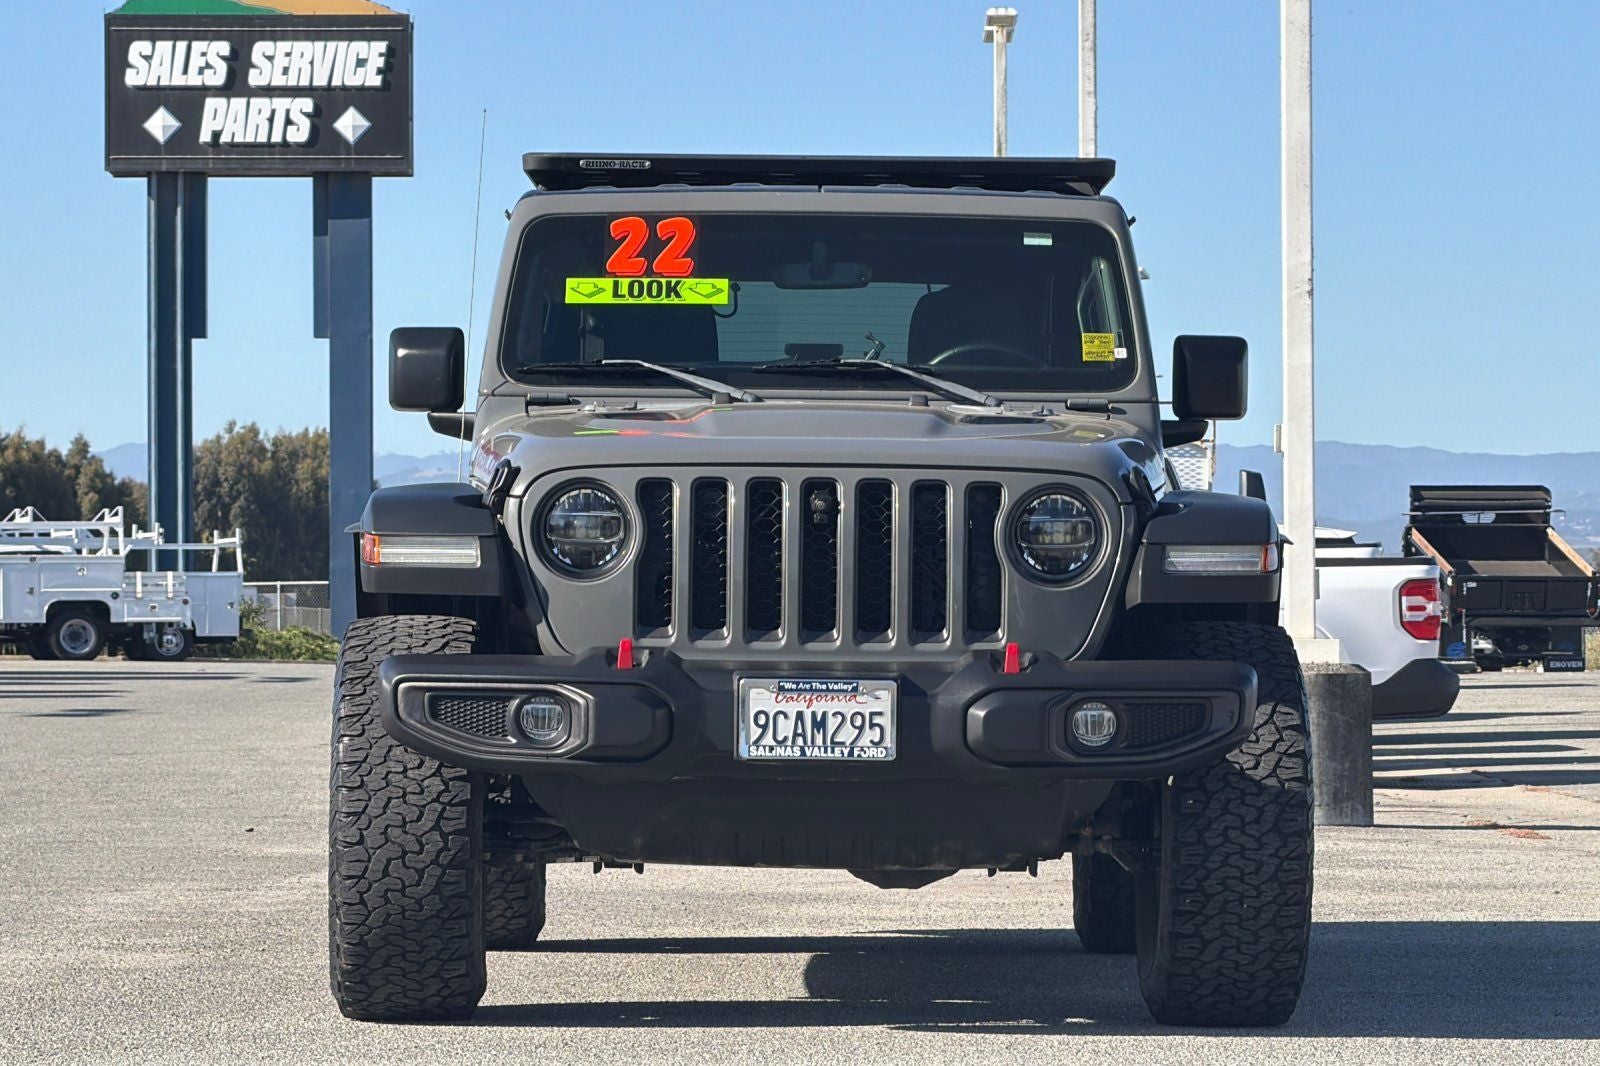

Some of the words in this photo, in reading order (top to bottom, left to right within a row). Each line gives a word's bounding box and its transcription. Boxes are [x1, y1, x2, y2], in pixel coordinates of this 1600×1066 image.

[124, 40, 232, 88] SALES
[247, 40, 388, 88] SERVICE
[198, 96, 315, 145] PARTS
[606, 216, 696, 277] 22
[611, 279, 685, 301] LOOK
[1550, 660, 1583, 668] ENOVEN
[797, 682, 810, 690] Are
[811, 682, 828, 690] The
[774, 692, 868, 709] California
[753, 709, 885, 746] 9CAM295
[749, 746, 801, 757] SALINAS
[804, 747, 850, 757] VALLEY
[853, 747, 887, 758] FORD
